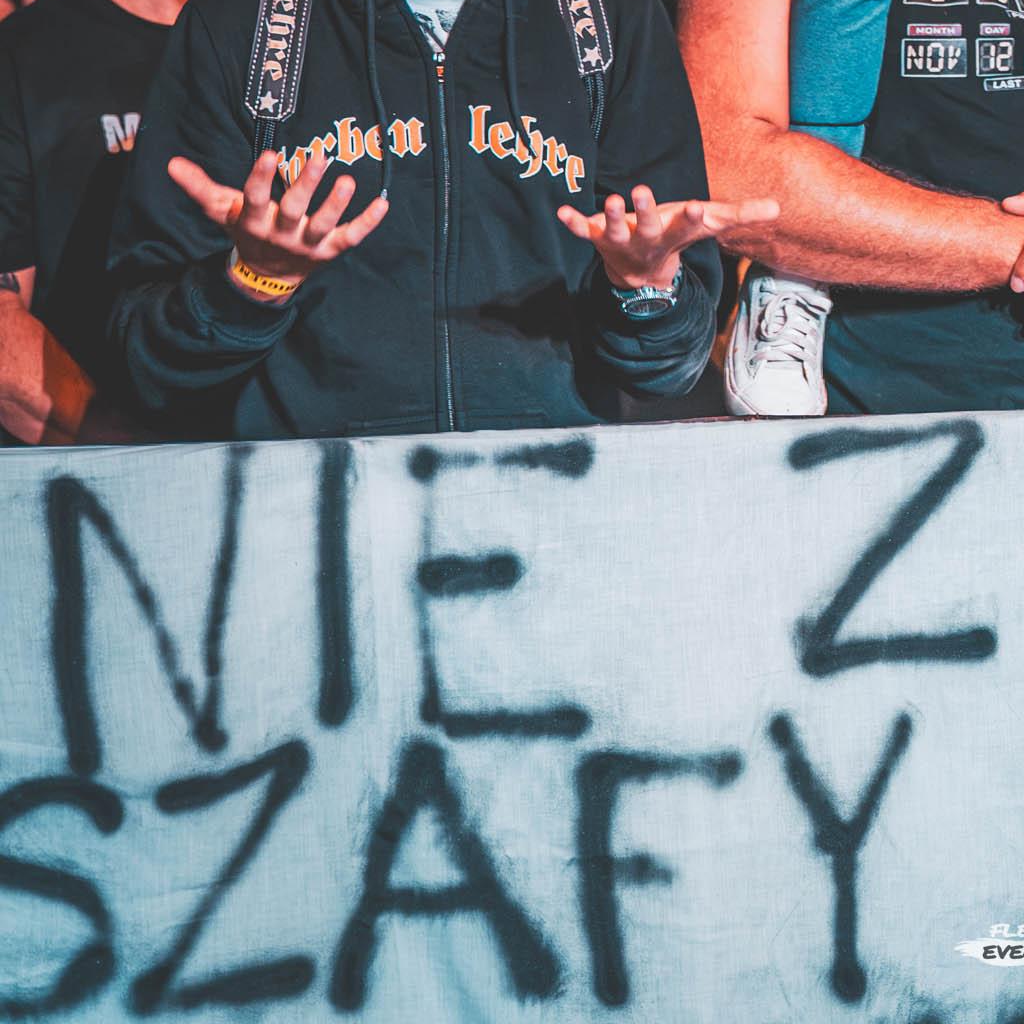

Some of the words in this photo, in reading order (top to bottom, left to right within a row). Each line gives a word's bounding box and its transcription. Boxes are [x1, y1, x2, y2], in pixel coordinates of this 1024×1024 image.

[915, 26, 956, 35] MONTH
[984, 26, 1006, 35] DAY
[906, 42, 961, 73] NOV
[989, 41, 1014, 72] 12
[992, 78, 1022, 89] LAST
[47, 435, 593, 777] NIE
[787, 418, 998, 678] Z
